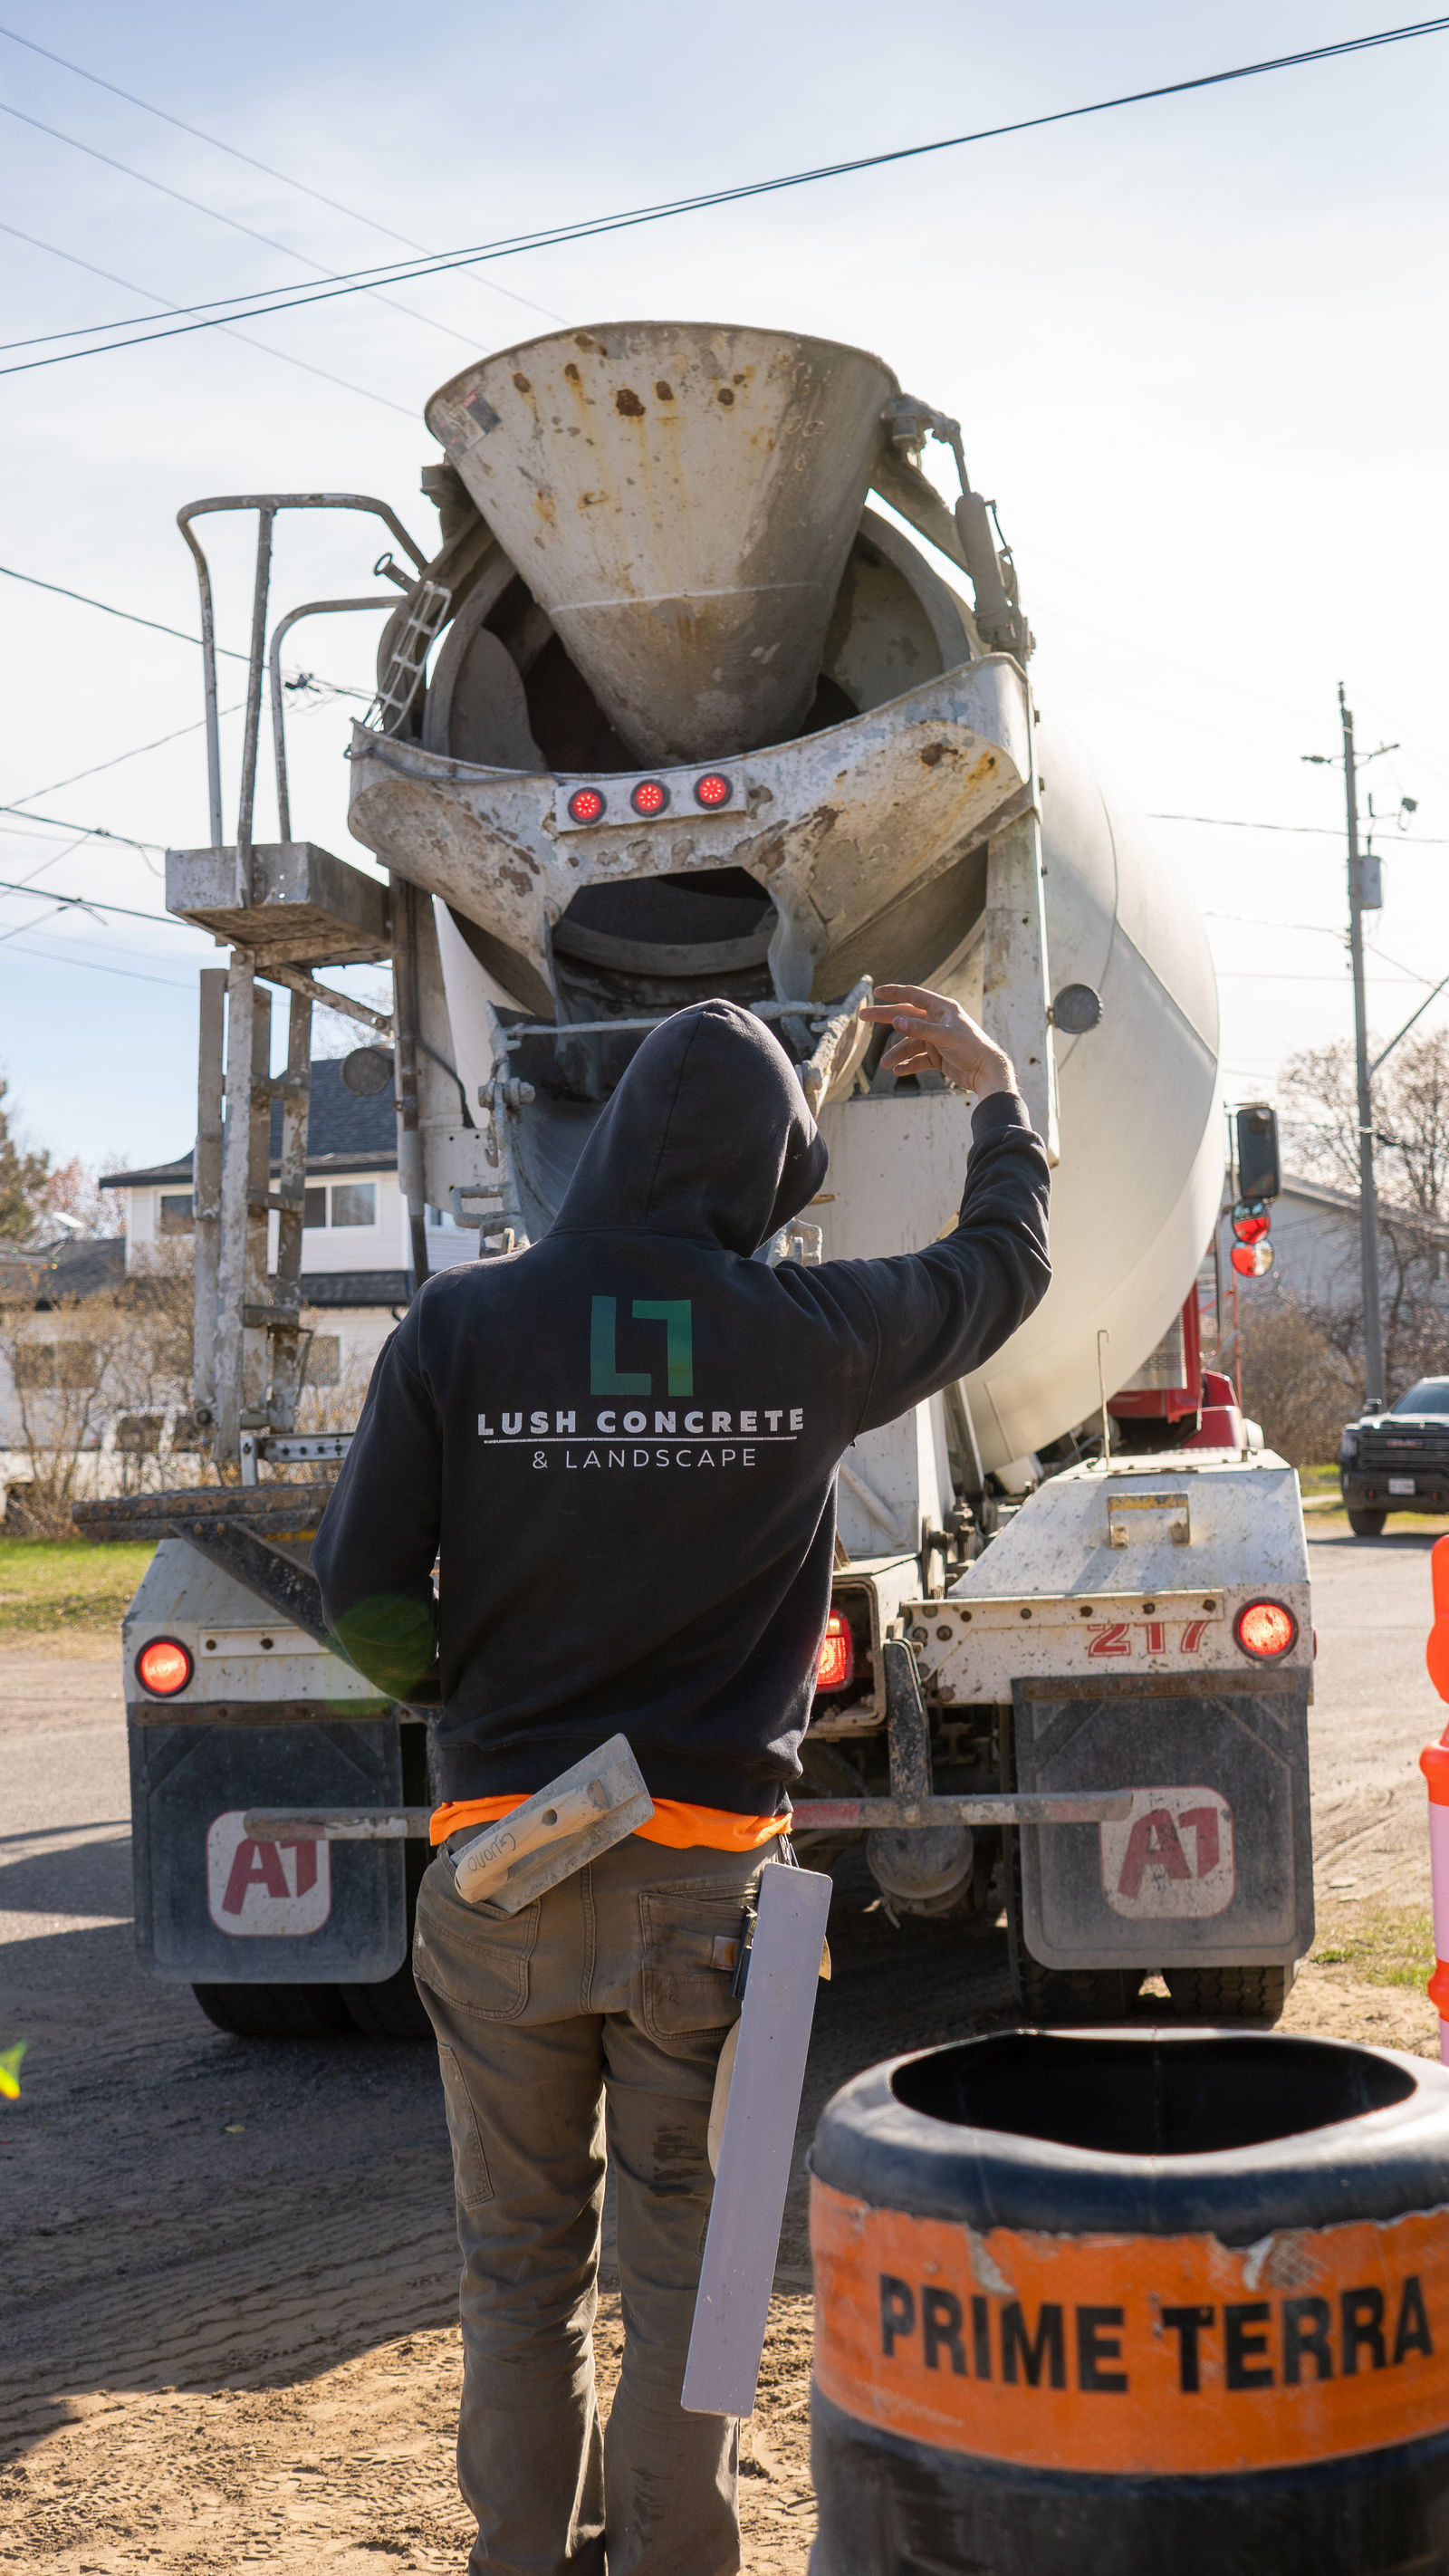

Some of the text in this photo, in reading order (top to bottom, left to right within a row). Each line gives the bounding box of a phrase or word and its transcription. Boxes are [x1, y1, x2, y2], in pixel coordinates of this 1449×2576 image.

[477, 1408, 804, 1436] LUSH CONCRETE
[532, 1448, 756, 1469] & LANDSCAPE
[1118, 1806, 1221, 1899] A1
[878, 2272, 1435, 2394] PRIME TERRA
